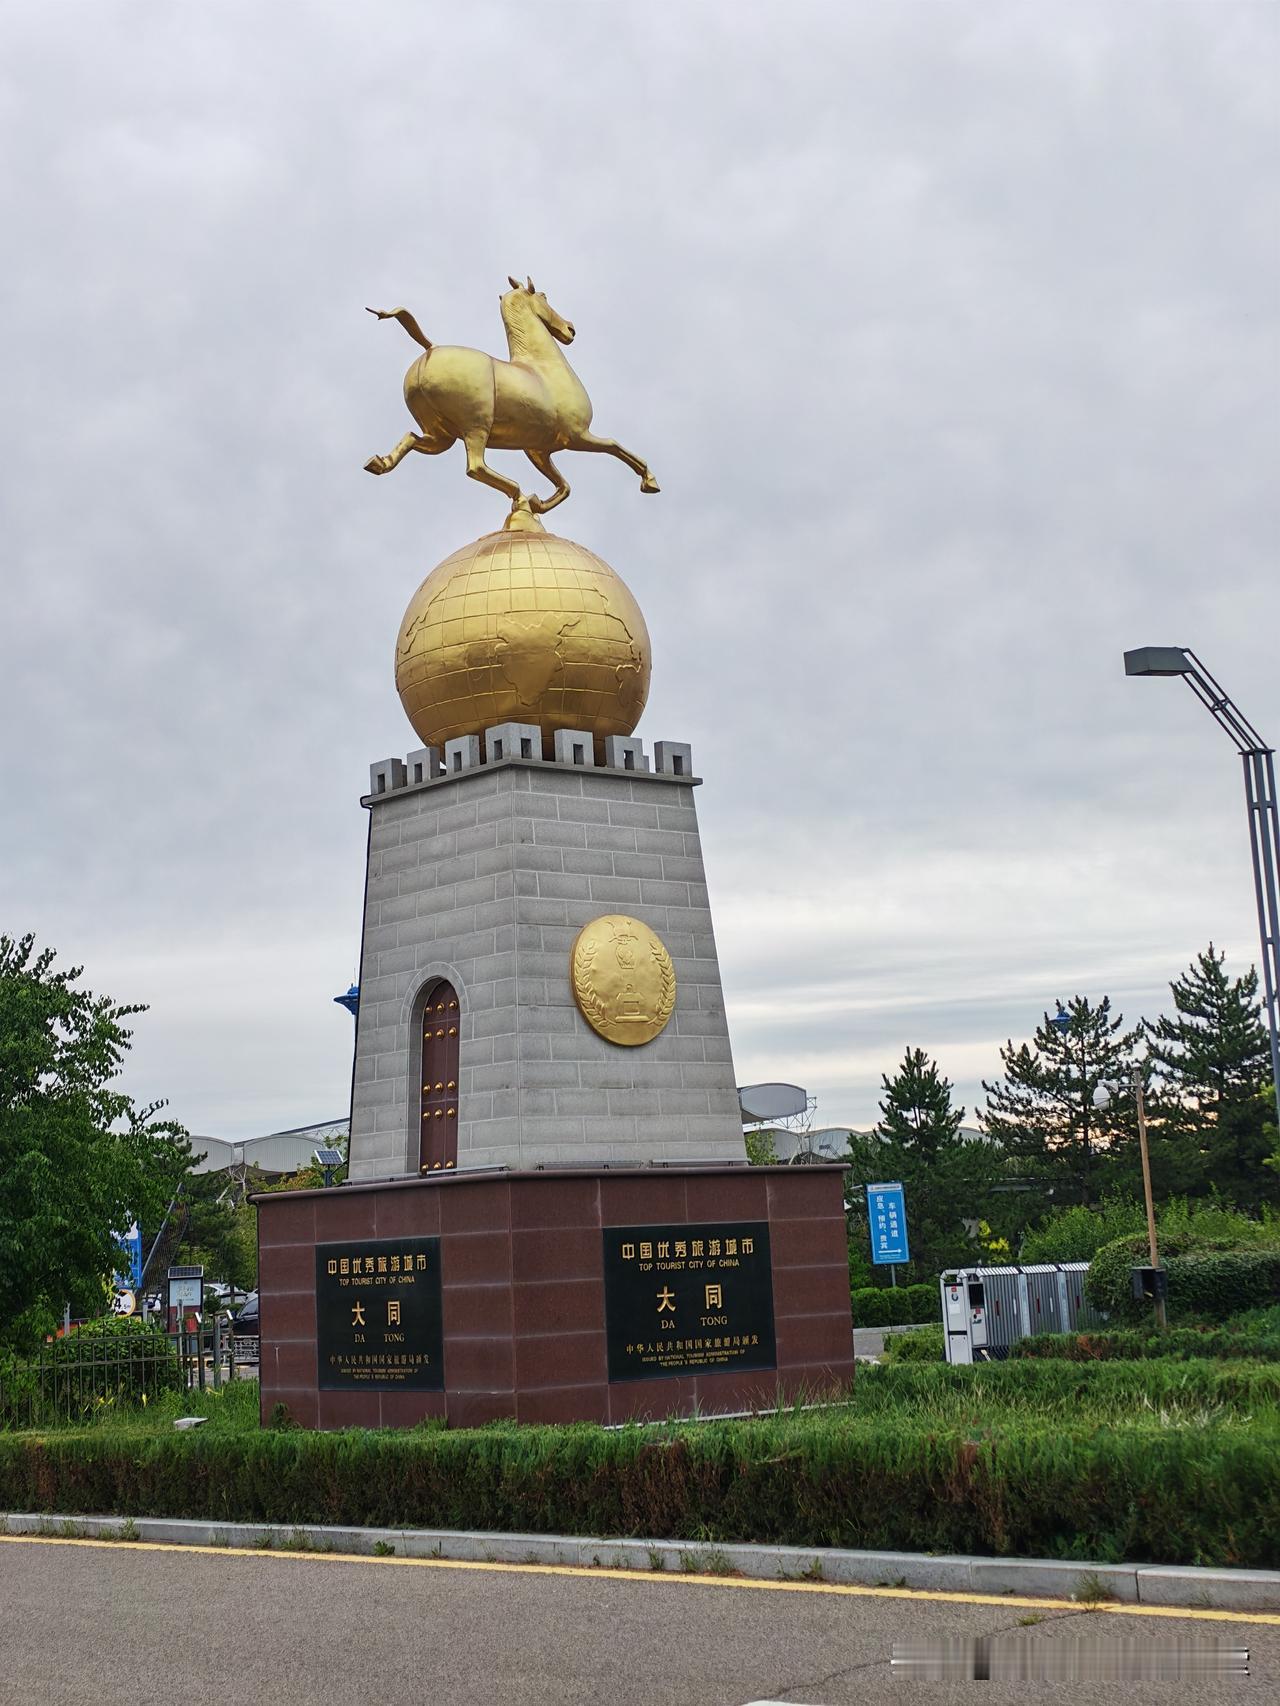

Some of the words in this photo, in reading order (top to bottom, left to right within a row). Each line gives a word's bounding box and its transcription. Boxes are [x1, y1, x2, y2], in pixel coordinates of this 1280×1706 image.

[622, 1238, 754, 1261] 中国优秀旅游城市
[328, 1254, 427, 1275] 中国优秀旅游城市
[639, 1263, 653, 1271] TOP
[656, 1261, 685, 1271] TOURIST
[689, 1260, 703, 1269] CITY
[707, 1260, 716, 1268] OF
[719, 1259, 739, 1267] CHINA
[340, 1278, 350, 1286] TOP
[352, 1277, 373, 1286] TOURIST
[375, 1276, 387, 1285] CITY
[389, 1276, 396, 1284] OF
[399, 1275, 415, 1284] CHINA
[657, 1286, 676, 1313] 大
[705, 1284, 722, 1310] 同
[352, 1301, 366, 1326] 大
[388, 1301, 400, 1326] 同
[661, 1319, 675, 1329] DA
[700, 1316, 728, 1326] TONG
[355, 1333, 365, 1343] DA
[384, 1333, 405, 1342] TONG
